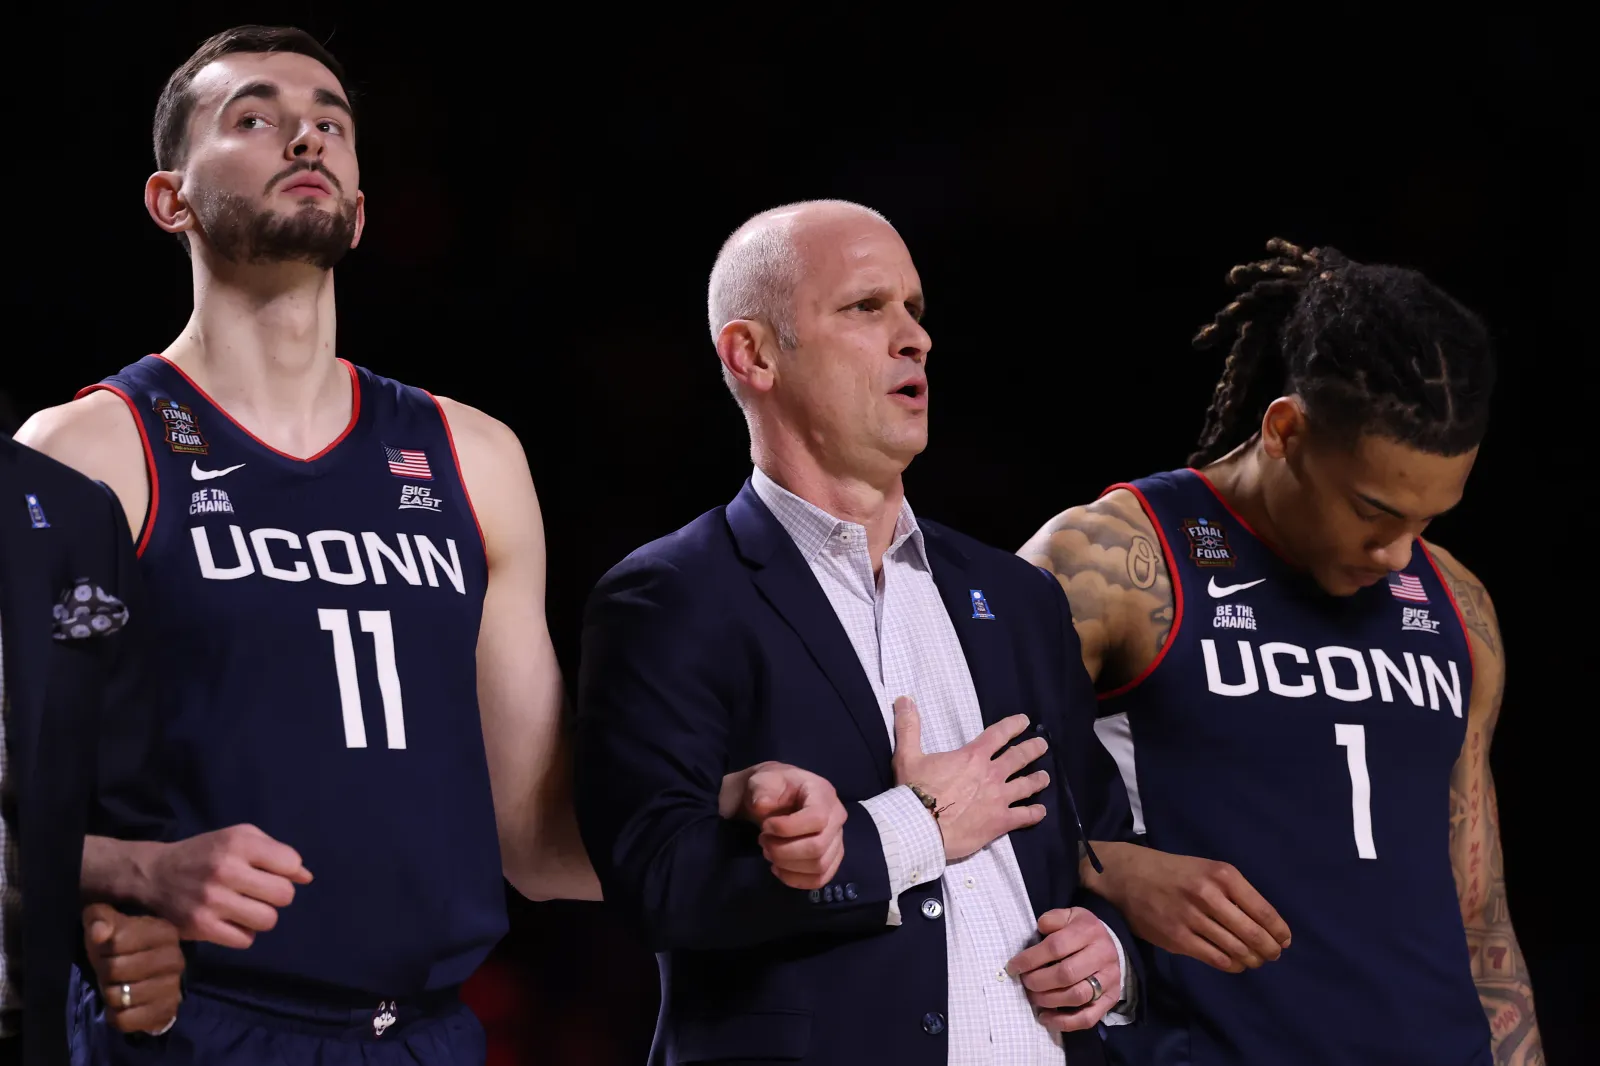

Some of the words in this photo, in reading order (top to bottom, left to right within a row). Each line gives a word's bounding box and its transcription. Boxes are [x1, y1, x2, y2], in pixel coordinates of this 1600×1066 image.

[162, 409, 194, 423] FINAL
[171, 432, 202, 445] FOUR
[191, 489, 208, 503] BE
[402, 485, 431, 496] BIG
[400, 495, 442, 507] EAST
[1188, 527, 1223, 538] FINAL
[190, 525, 466, 595] UCONN
[1196, 548, 1229, 559] FOUR
[1216, 605, 1232, 616] BE
[1235, 605, 1254, 618] THE
[1402, 607, 1429, 619] BIG
[1213, 616, 1257, 630] CHANGE
[1402, 616, 1440, 629] EAST
[317, 608, 407, 750] 11
[1200, 639, 1463, 718] UCONN
[1334, 723, 1377, 860] 1
[1487, 945, 1508, 970] 7
